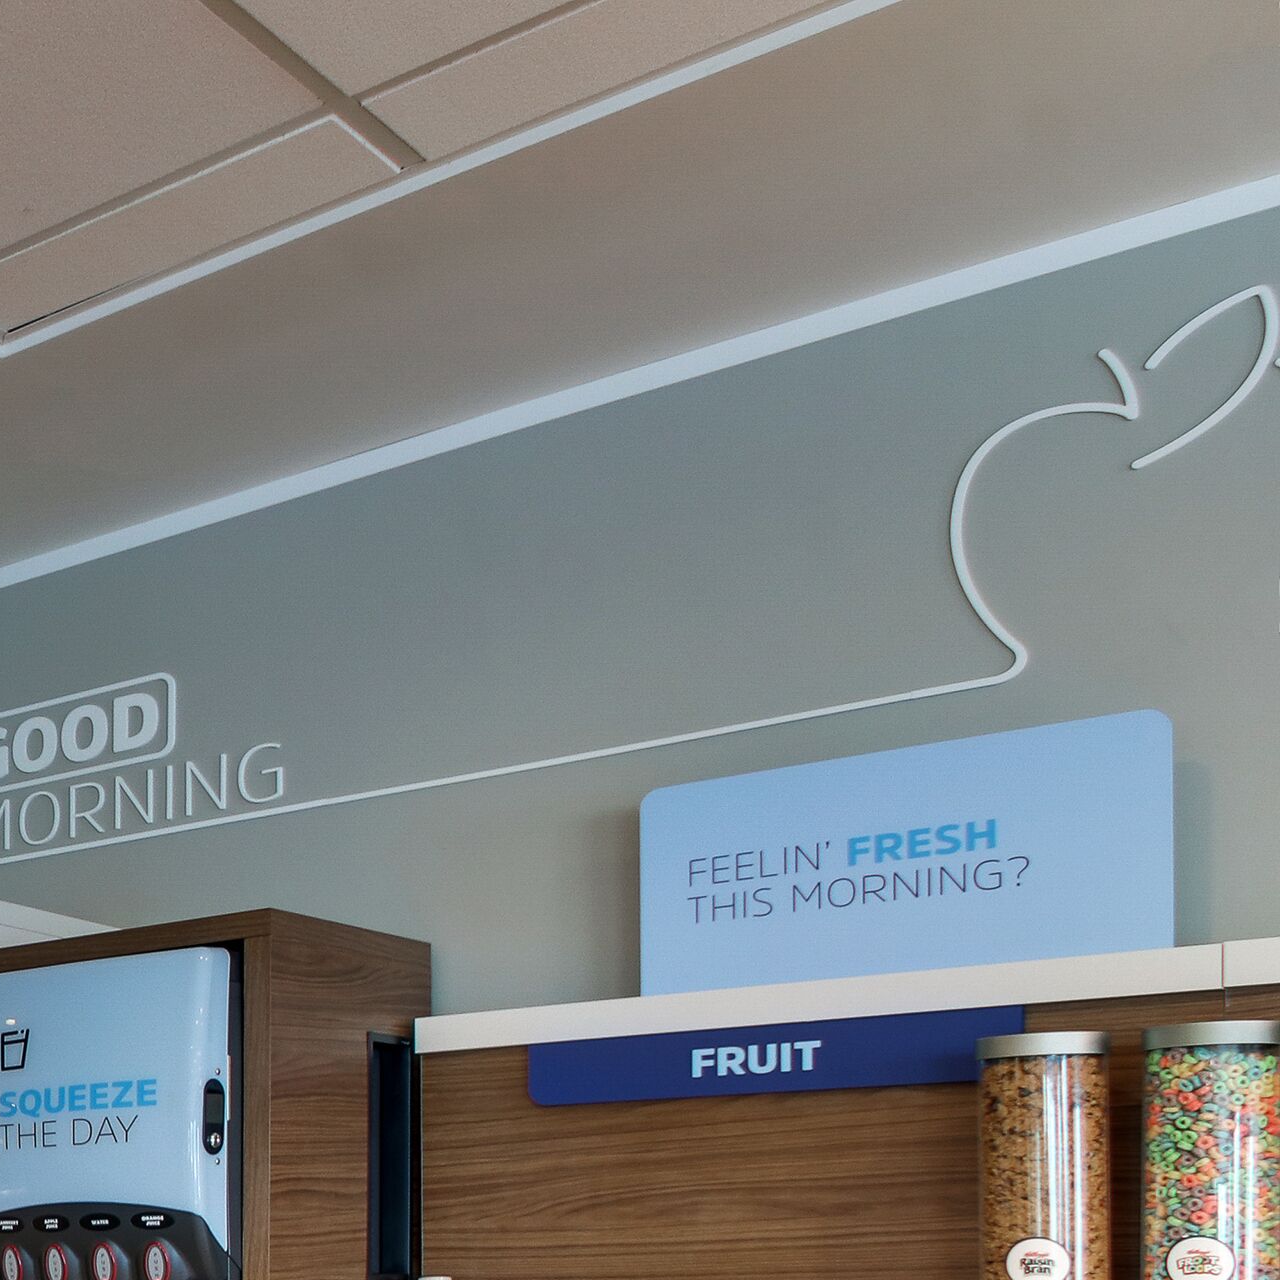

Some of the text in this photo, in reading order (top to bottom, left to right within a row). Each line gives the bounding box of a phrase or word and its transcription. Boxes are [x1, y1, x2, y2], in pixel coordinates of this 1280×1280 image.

[688, 819, 997, 887] FEELIN' FRESH
[687, 855, 1030, 924] THIS MORNING?
[690, 1039, 822, 1079] FRUIT
[0, 1078, 157, 1118] SQUEEZE
[72, 1114, 138, 1145] DAY
